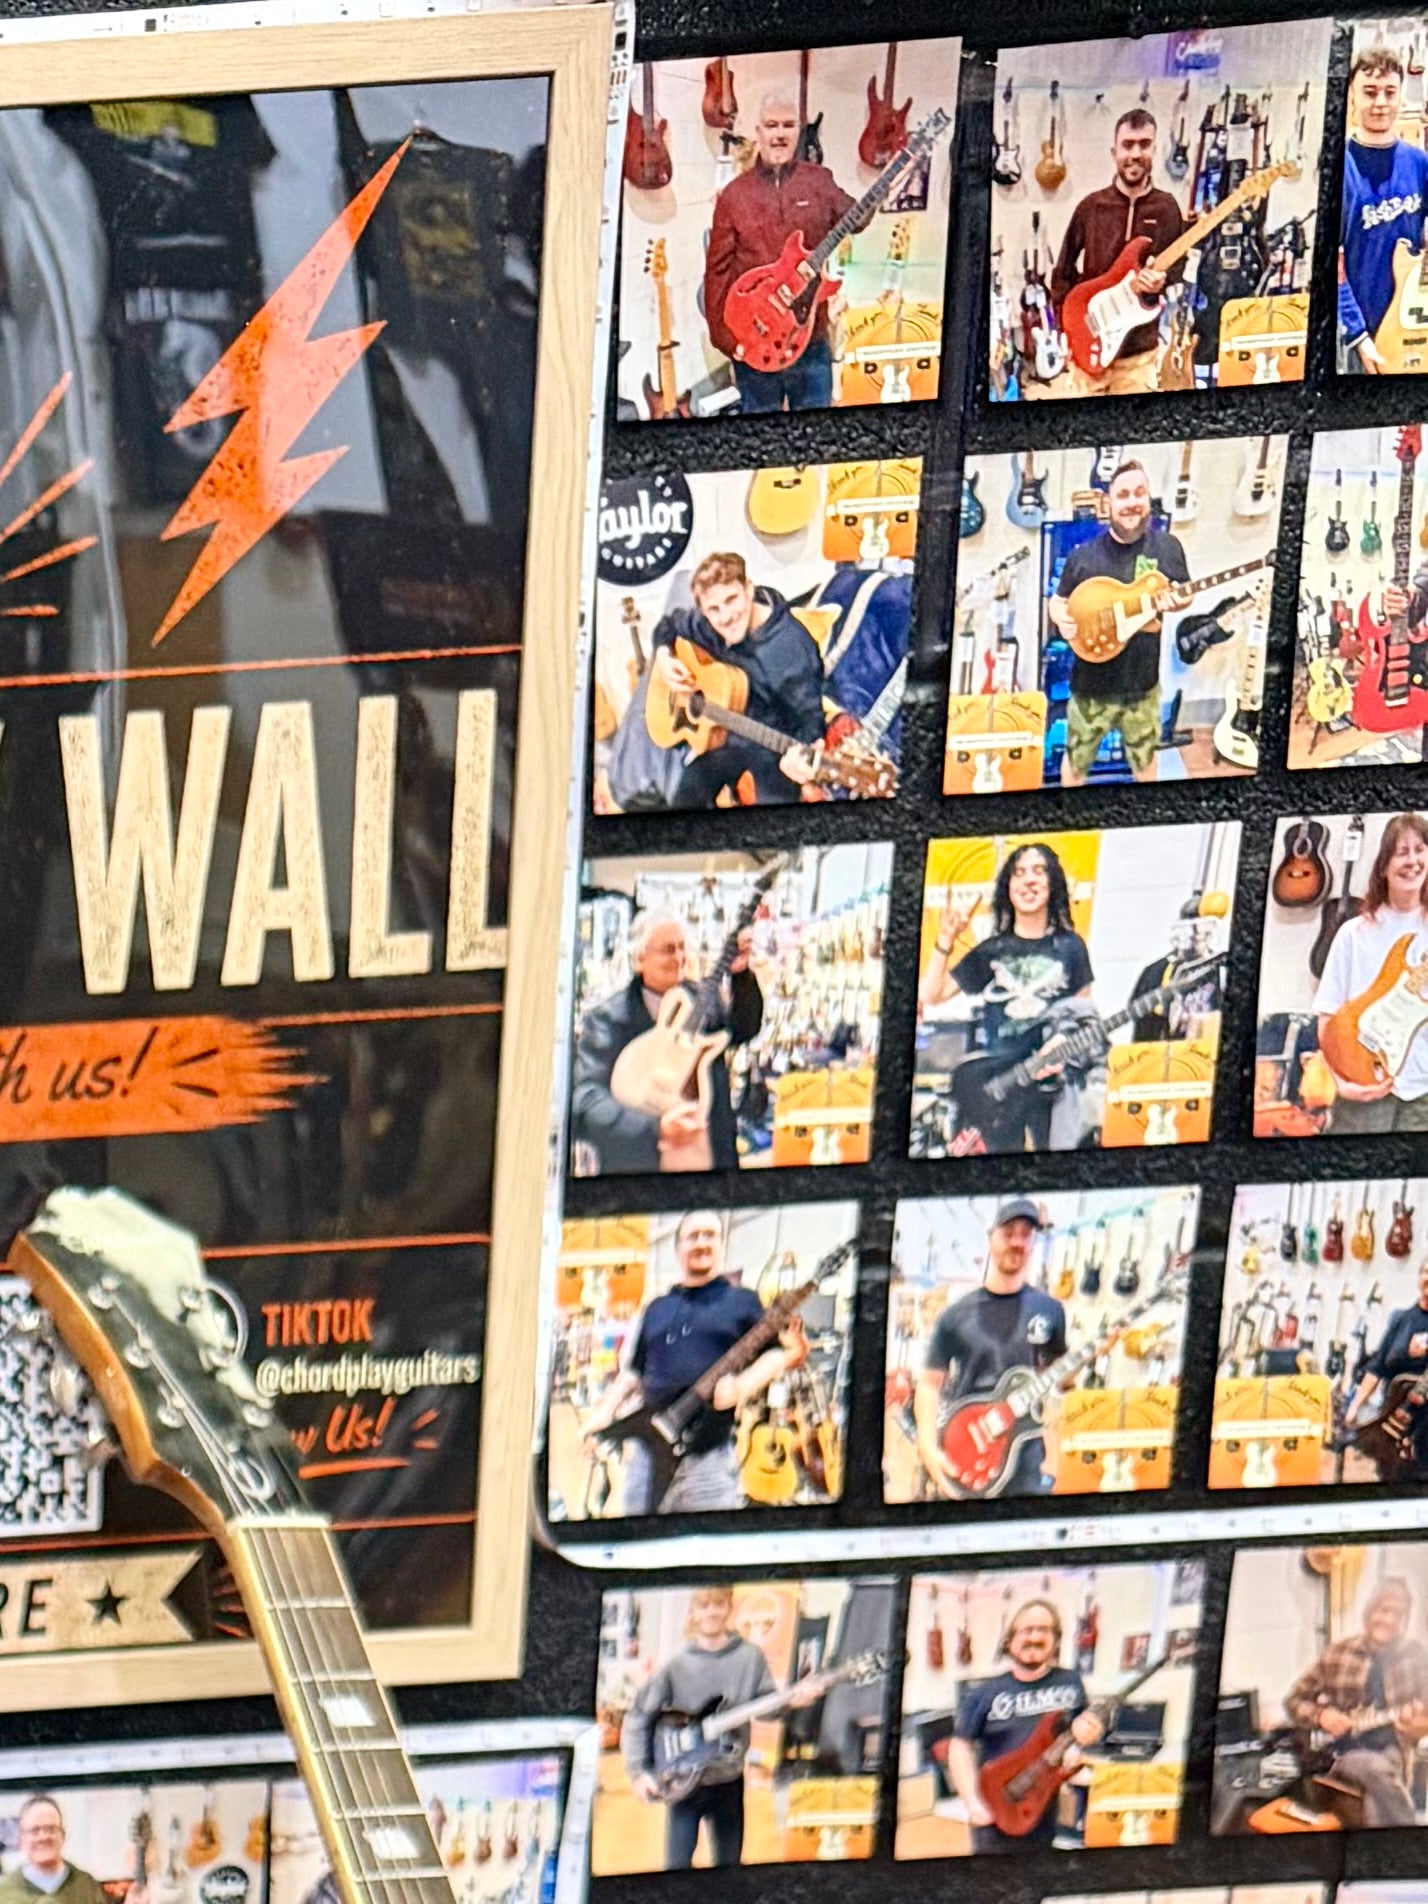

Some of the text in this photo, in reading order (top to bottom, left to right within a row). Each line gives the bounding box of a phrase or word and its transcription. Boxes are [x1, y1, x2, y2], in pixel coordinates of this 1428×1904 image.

[58, 689, 510, 995] WALL
[49, 1024, 159, 1101] us!
[261, 1298, 375, 1347] TIKTOK
[255, 1349, 482, 1398] @chordplayguitars
[325, 1396, 398, 1454] Us!
